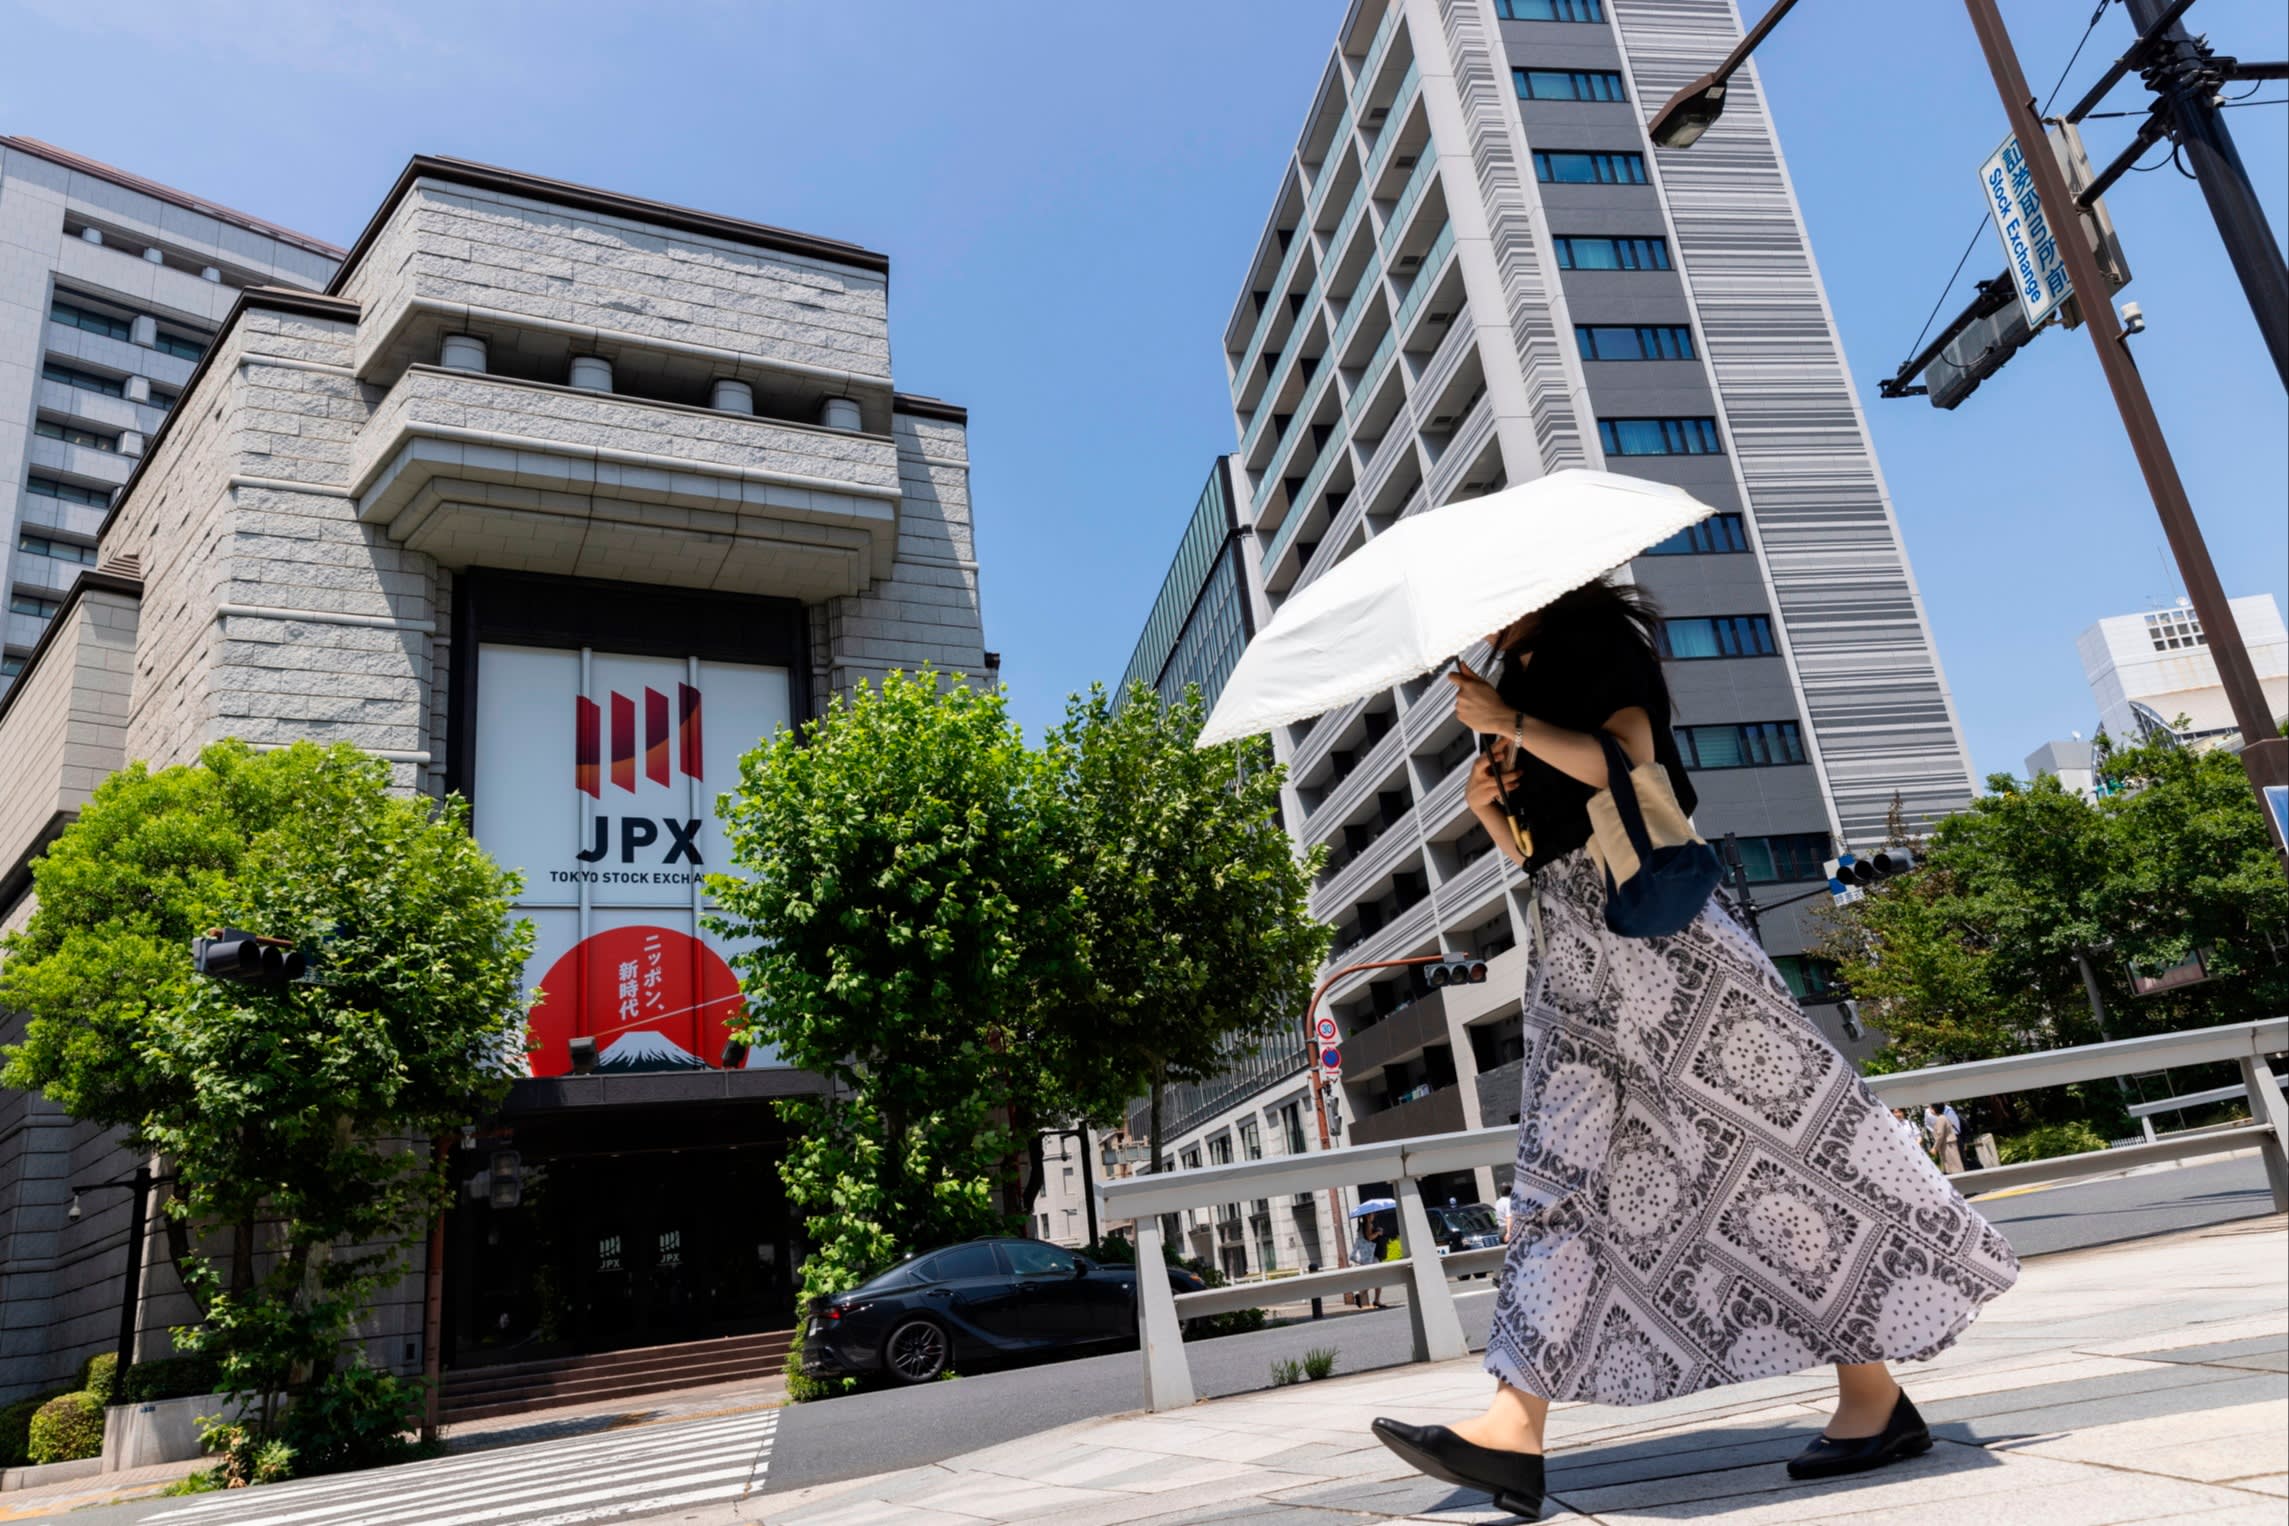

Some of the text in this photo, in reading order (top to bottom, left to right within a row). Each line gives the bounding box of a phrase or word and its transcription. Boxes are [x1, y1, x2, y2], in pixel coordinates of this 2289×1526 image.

[1989, 167, 2042, 304] Stock Exchange
[576, 815, 704, 865] JPX
[550, 871, 705, 885] TOKYO STOCK EXCHA
[619, 959, 639, 1020] 新時代
[1321, 1023, 1333, 1035] 30
[600, 1259, 621, 1269] JPX
[660, 1253, 680, 1264] JPX
